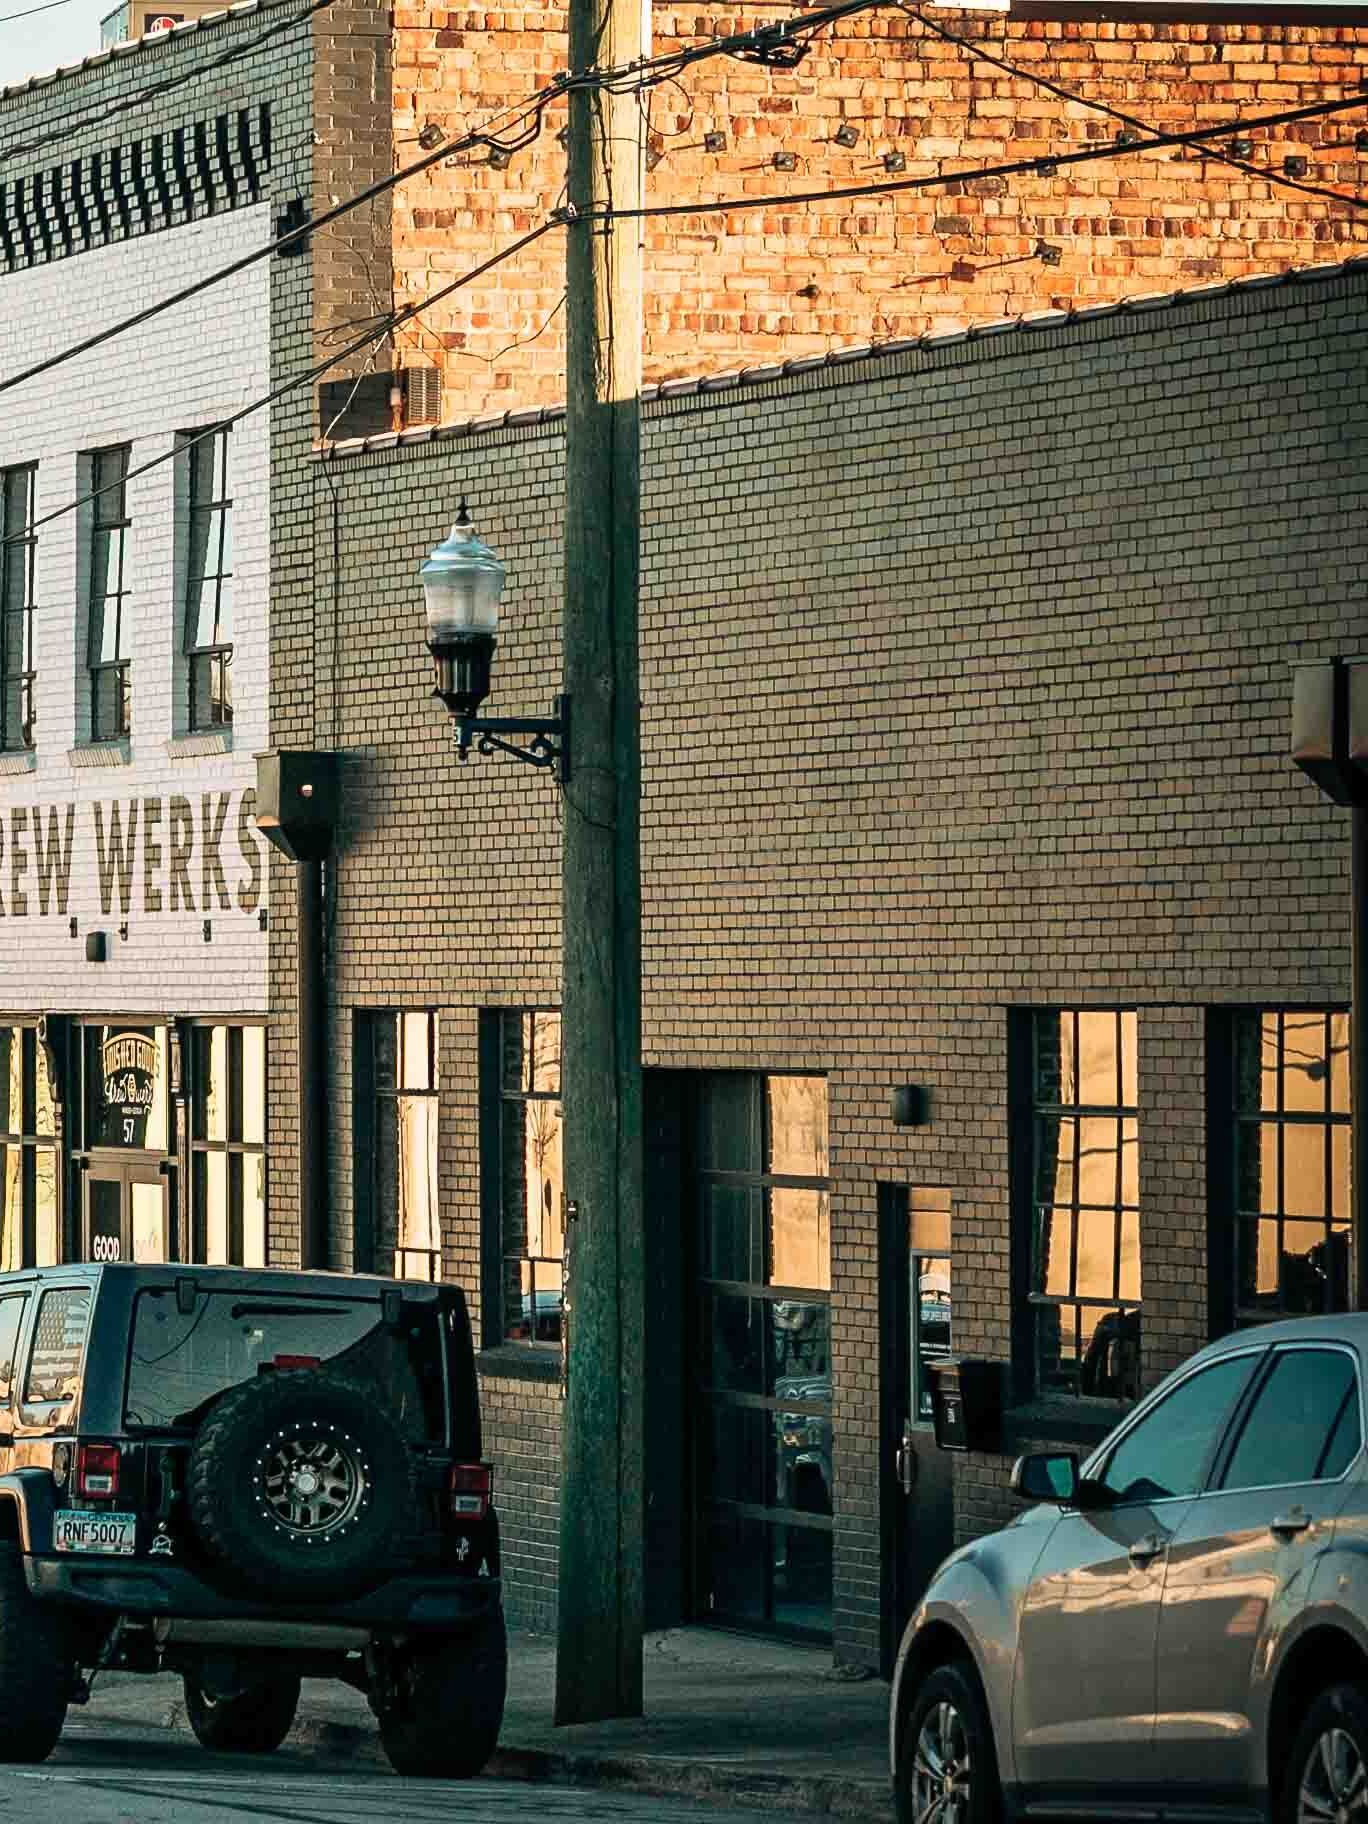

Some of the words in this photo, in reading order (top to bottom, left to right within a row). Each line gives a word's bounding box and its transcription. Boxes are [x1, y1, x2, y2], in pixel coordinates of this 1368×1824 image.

[93, 787, 261, 914] WERKS
[123, 1118, 134, 1143] 57
[94, 1235, 120, 1261] GOOD
[63, 1521, 126, 1543] RNF5007
